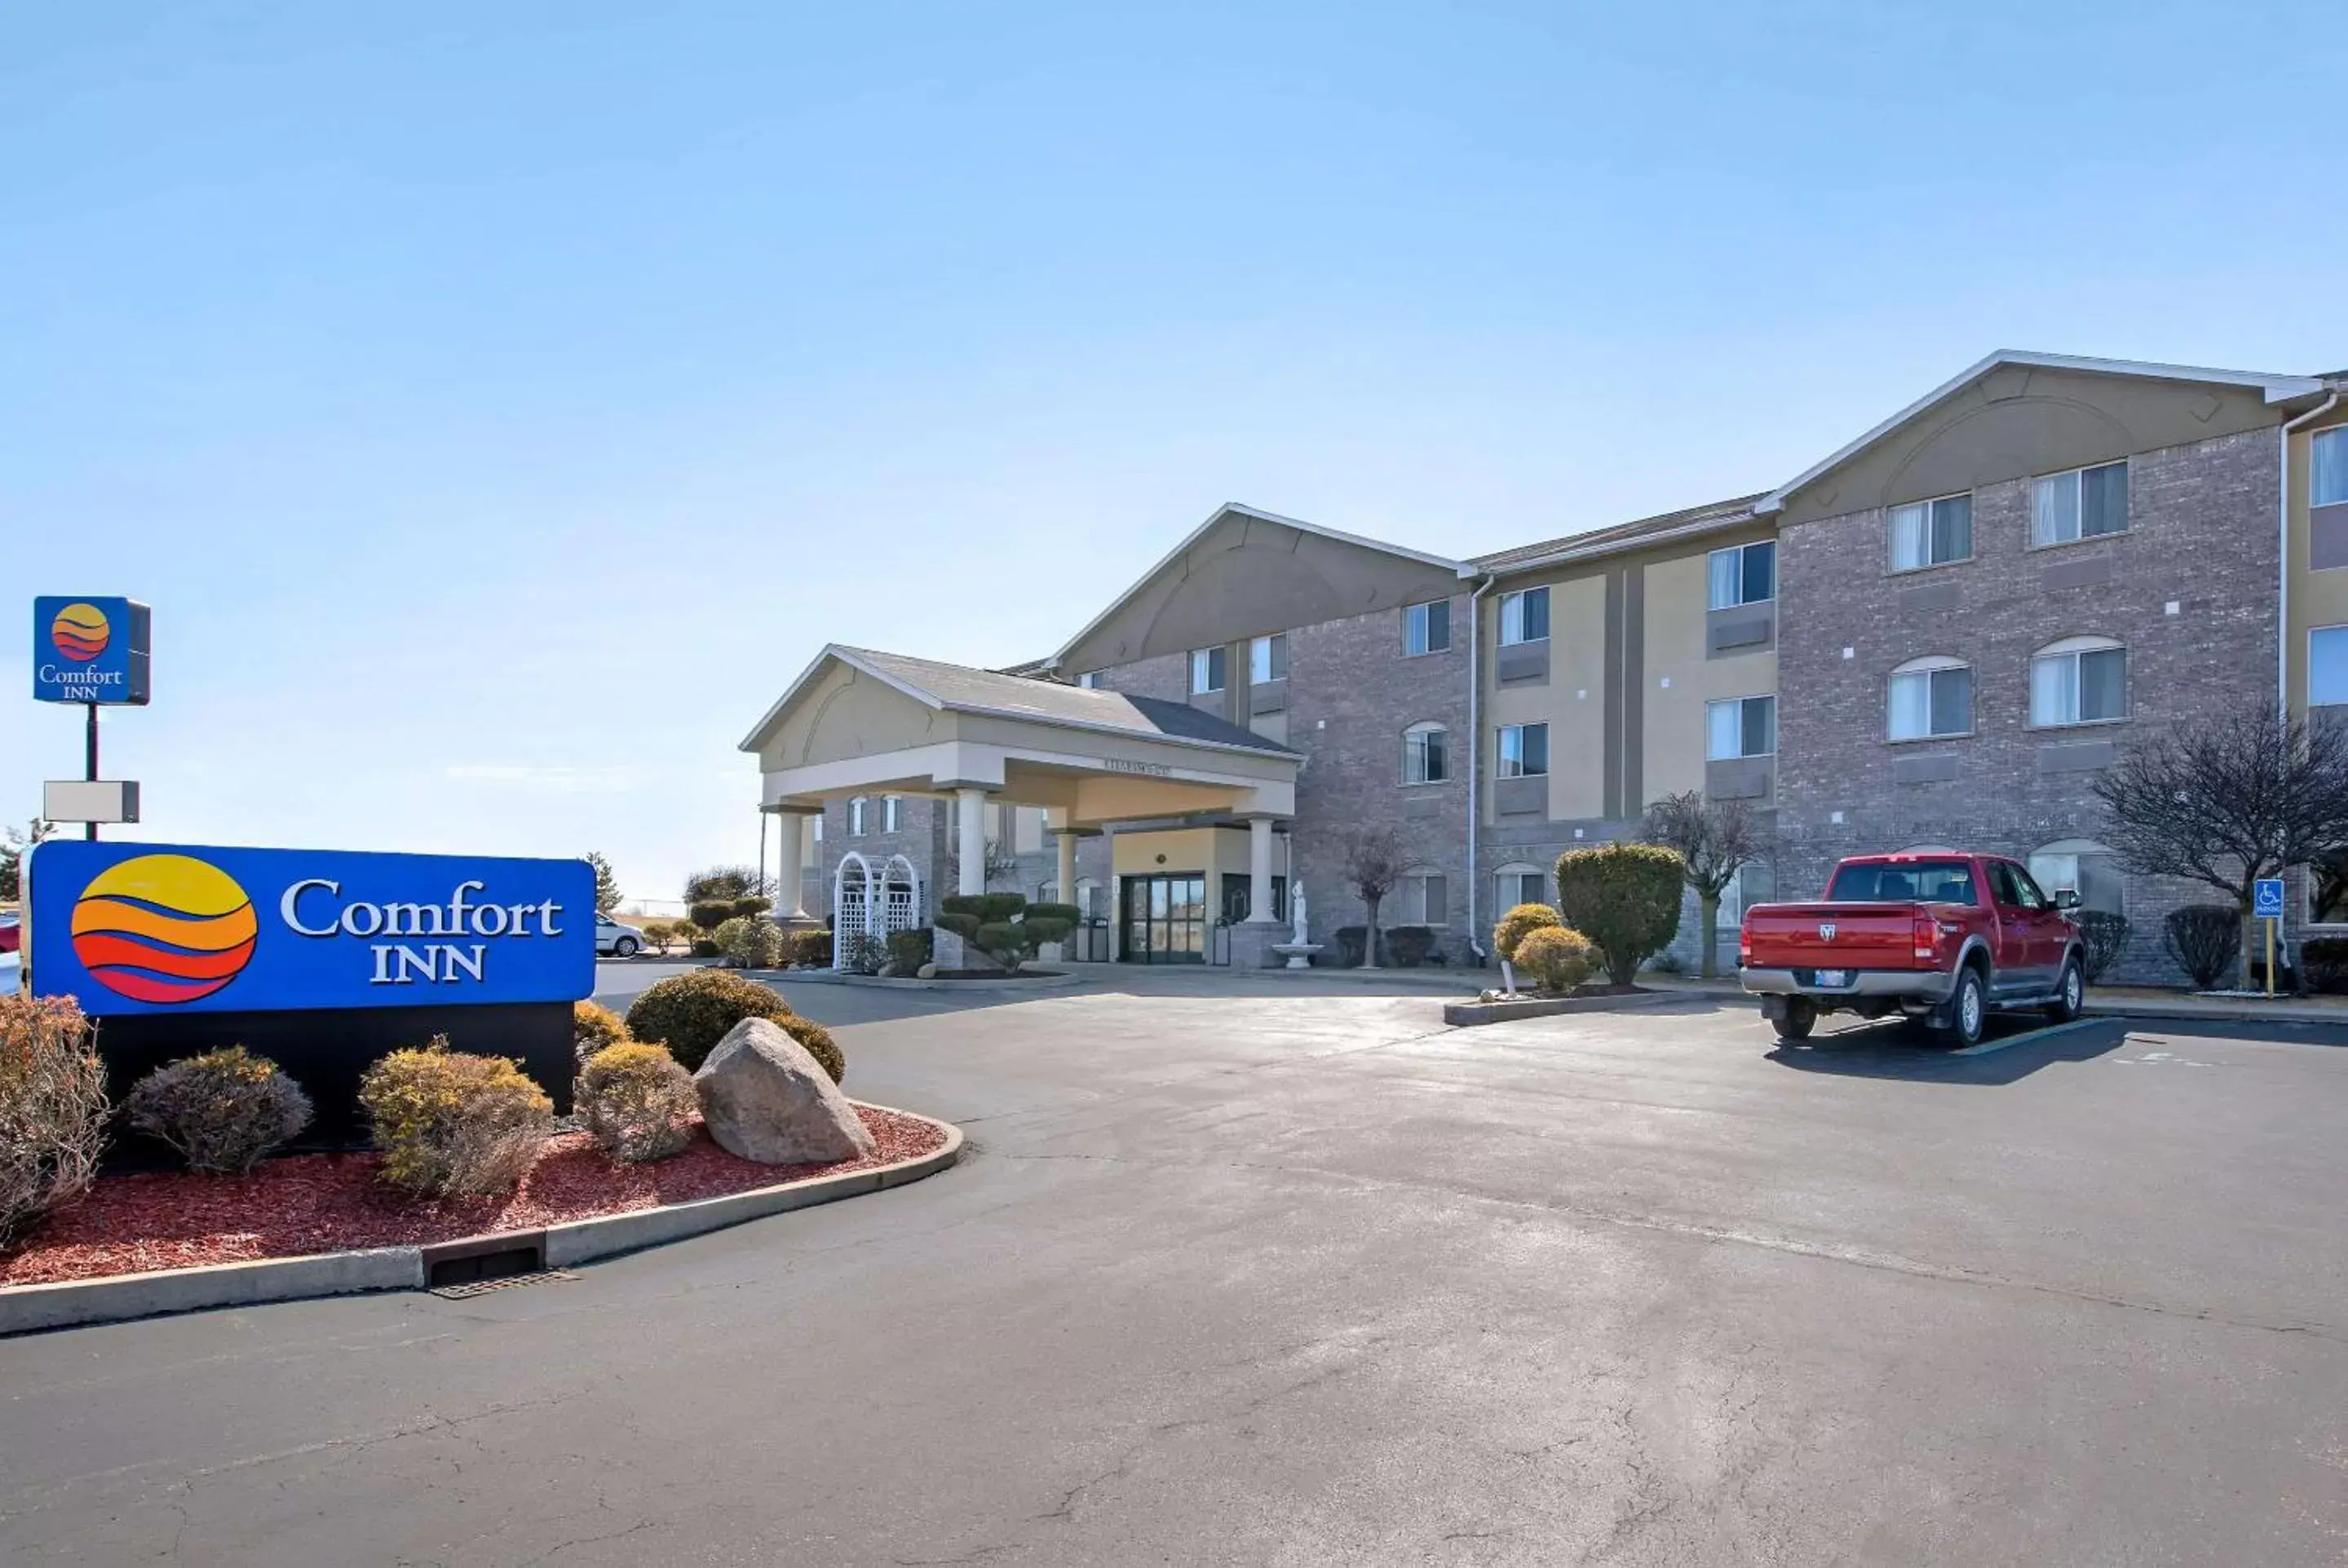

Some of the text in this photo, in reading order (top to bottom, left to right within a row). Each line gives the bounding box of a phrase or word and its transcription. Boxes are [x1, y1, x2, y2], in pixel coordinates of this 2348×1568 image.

[39, 665, 122, 685] Comfort
[63, 687, 97, 699] INN
[281, 878, 564, 937] Comfort
[369, 944, 487, 983] INN
